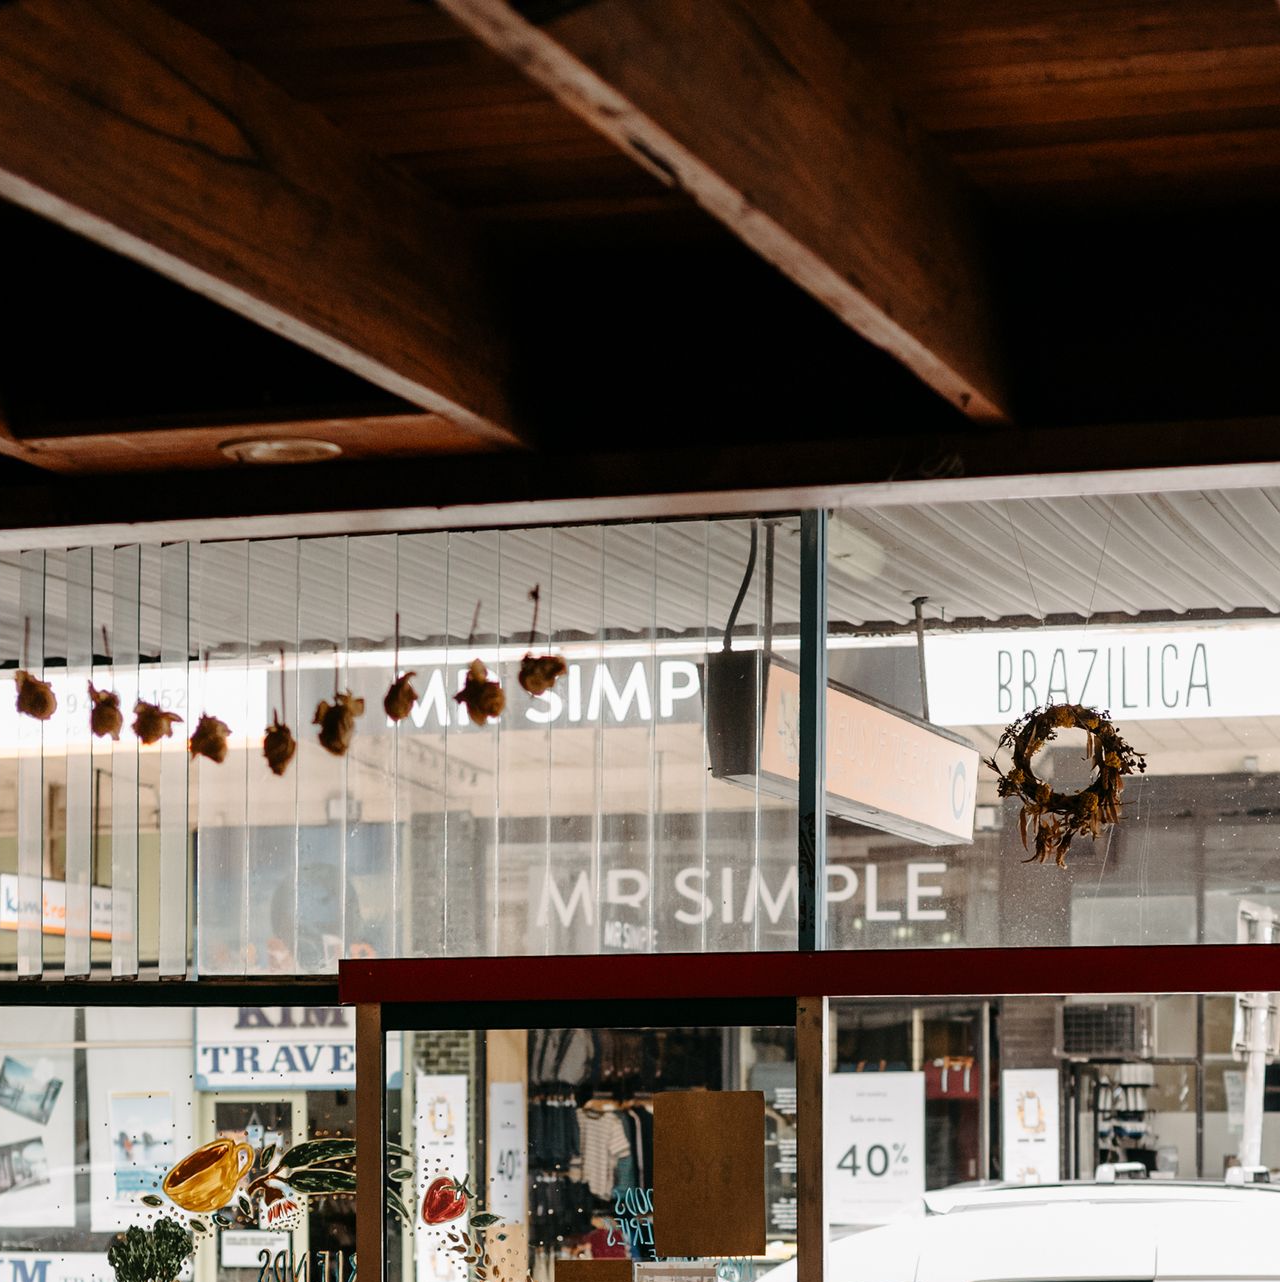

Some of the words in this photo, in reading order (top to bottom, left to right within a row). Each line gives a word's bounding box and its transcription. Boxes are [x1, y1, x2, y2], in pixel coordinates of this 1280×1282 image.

[525, 661, 700, 723] SIMP
[998, 643, 1211, 713] BRAZILICA
[536, 868, 651, 928] MR
[674, 863, 947, 925] SIMPLE
[202, 1045, 355, 1074] TRAVE
[836, 1142, 909, 1177] 40%
